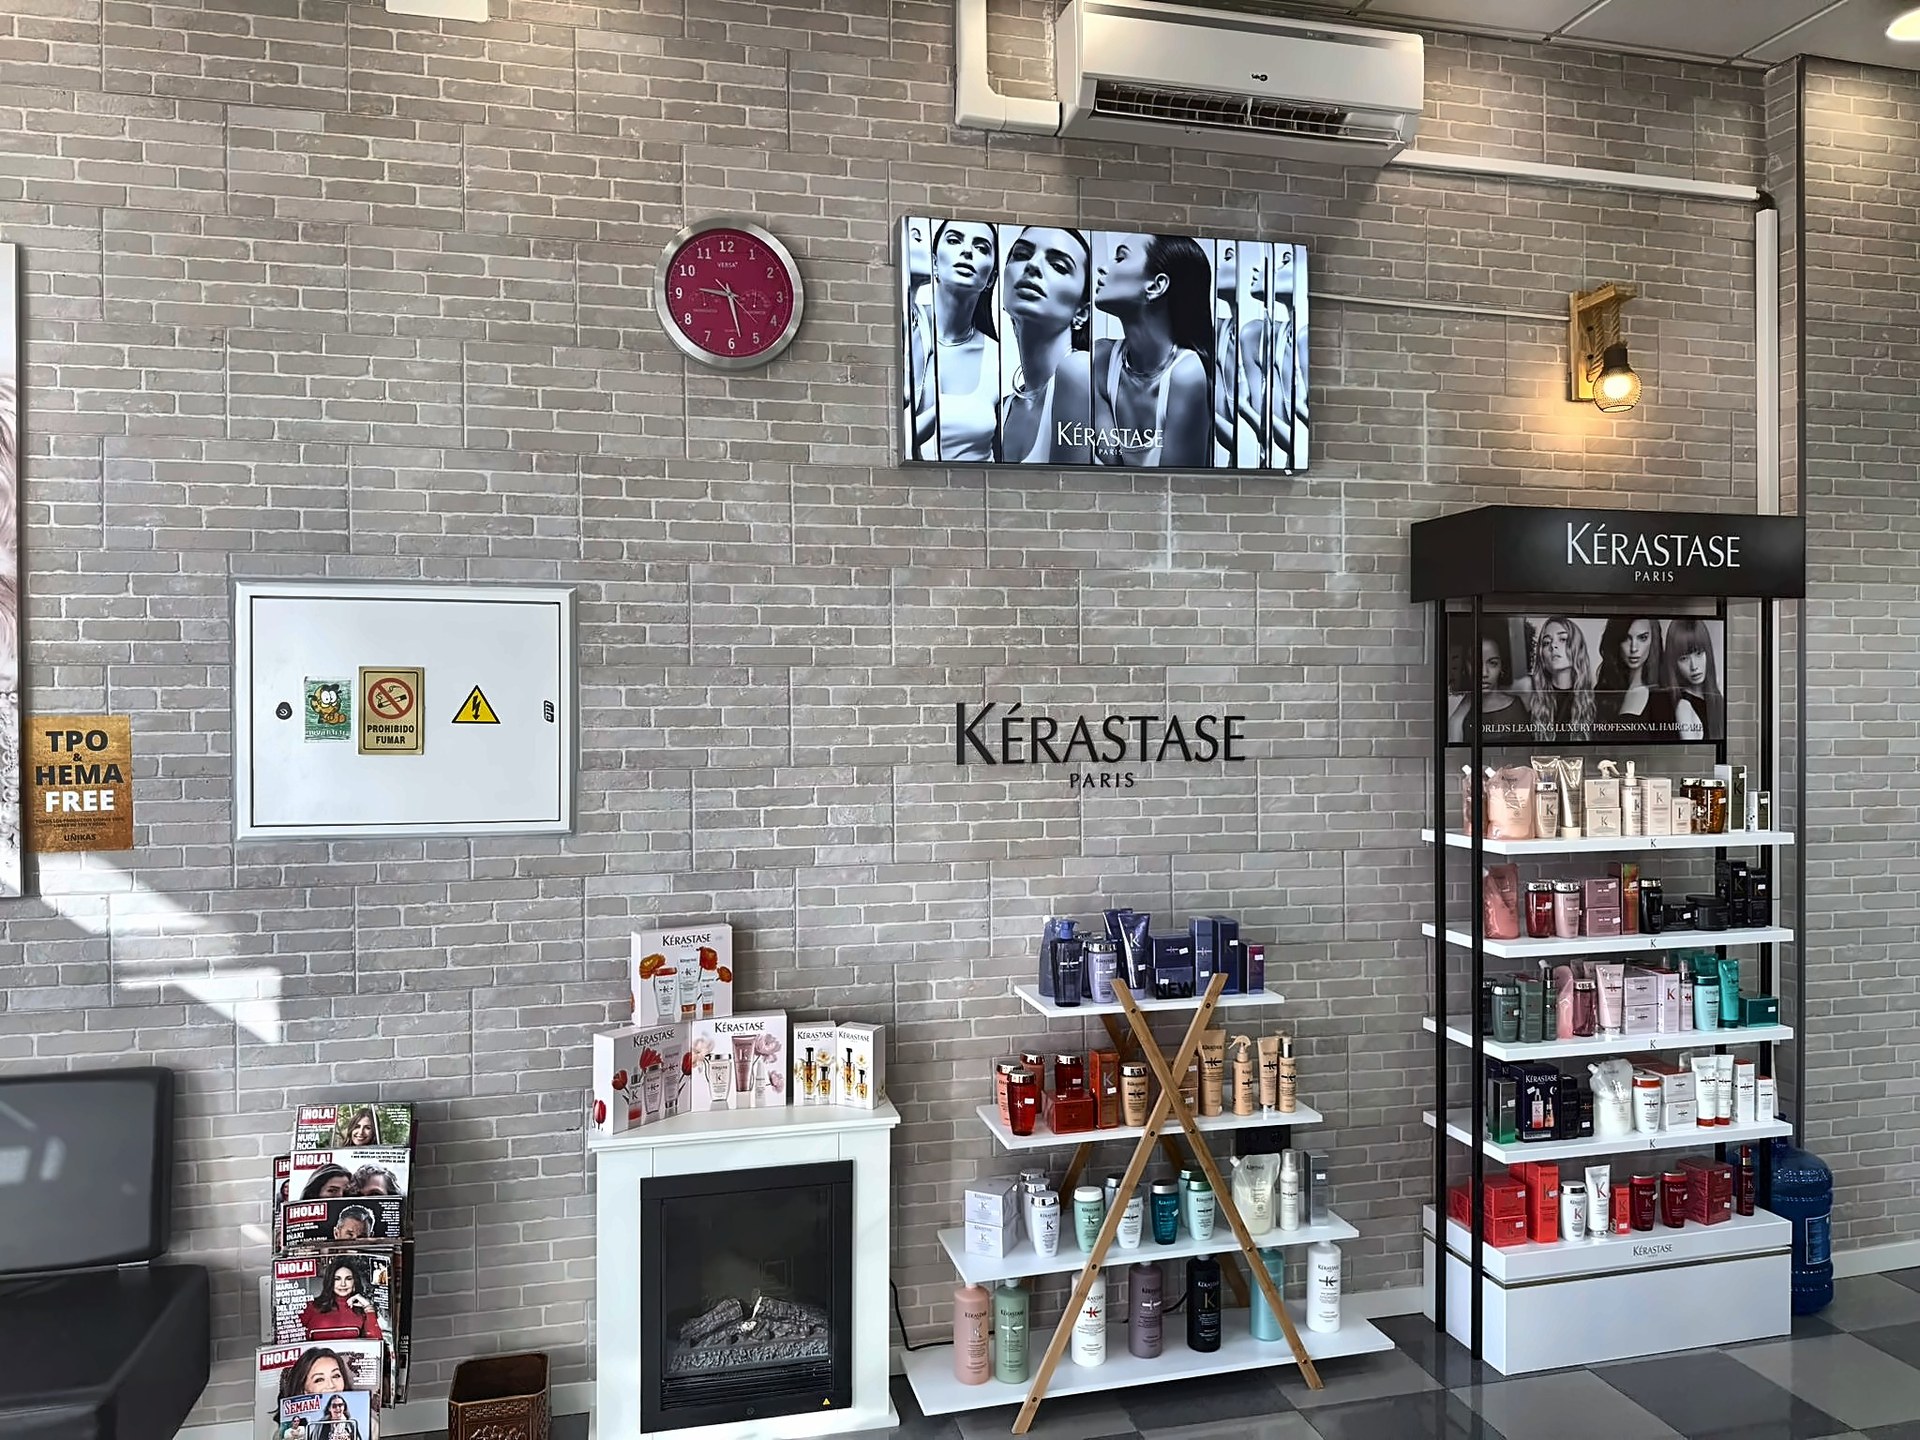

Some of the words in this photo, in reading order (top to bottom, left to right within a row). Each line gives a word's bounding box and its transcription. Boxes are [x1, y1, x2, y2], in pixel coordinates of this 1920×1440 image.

[719, 241, 734, 253] 12
[697, 248, 712, 260] 11
[749, 249, 756, 260] 1
[680, 264, 695, 277] 10
[766, 267, 774, 279] 2
[675, 287, 683, 299] 9
[776, 291, 783, 303] 3
[684, 312, 692, 325] 8
[770, 315, 777, 327] 4
[704, 330, 711, 342] 7
[753, 332, 760, 344] 5
[728, 338, 735, 349] 6
[1057, 421, 1164, 448] KÉRASTASE
[1567, 522, 1741, 568] KÉRASTASE
[1634, 571, 1674, 582] PARIS
[367, 725, 415, 733] PROHIBIDO
[956, 702, 1246, 765] KÉRASTASE
[1482, 723, 1510, 733] RLD'S
[1512, 723, 1554, 733] LEADING
[1555, 723, 1592, 732] LUXURY
[1593, 722, 1658, 732] PROFESSIONAL
[45, 730, 109, 752] TPO
[375, 736, 406, 744] FUMAR
[72, 753, 82, 761] &
[36, 764, 124, 785] HEMA
[1069, 772, 1135, 788] PARIS
[45, 789, 115, 812] FREE
[1650, 838, 1657, 847] K
[662, 933, 711, 947] KÉRASTASE
[1650, 938, 1657, 948] K
[1667, 988, 1675, 1000] K
[715, 1021, 764, 1033] KÉRASTASE
[633, 1028, 675, 1047] KÉRASTASE
[797, 1031, 833, 1039] KÉRASTASE
[1650, 1039, 1657, 1049] K
[1525, 1074, 1558, 1084] KÉRASTASE
[301, 1108, 334, 1119] ¡HOLA!
[1650, 1139, 1656, 1149] K
[296, 1153, 332, 1166] ¡HOLA!
[1597, 1183, 1606, 1198] K
[289, 1203, 324, 1219] ¡HOLA!
[1633, 1244, 1672, 1256] KÉRASTASE
[278, 1261, 313, 1274] ¡HOLA!
[262, 1350, 299, 1366] ¡HOLA!
[284, 1395, 321, 1415] SEMANA
